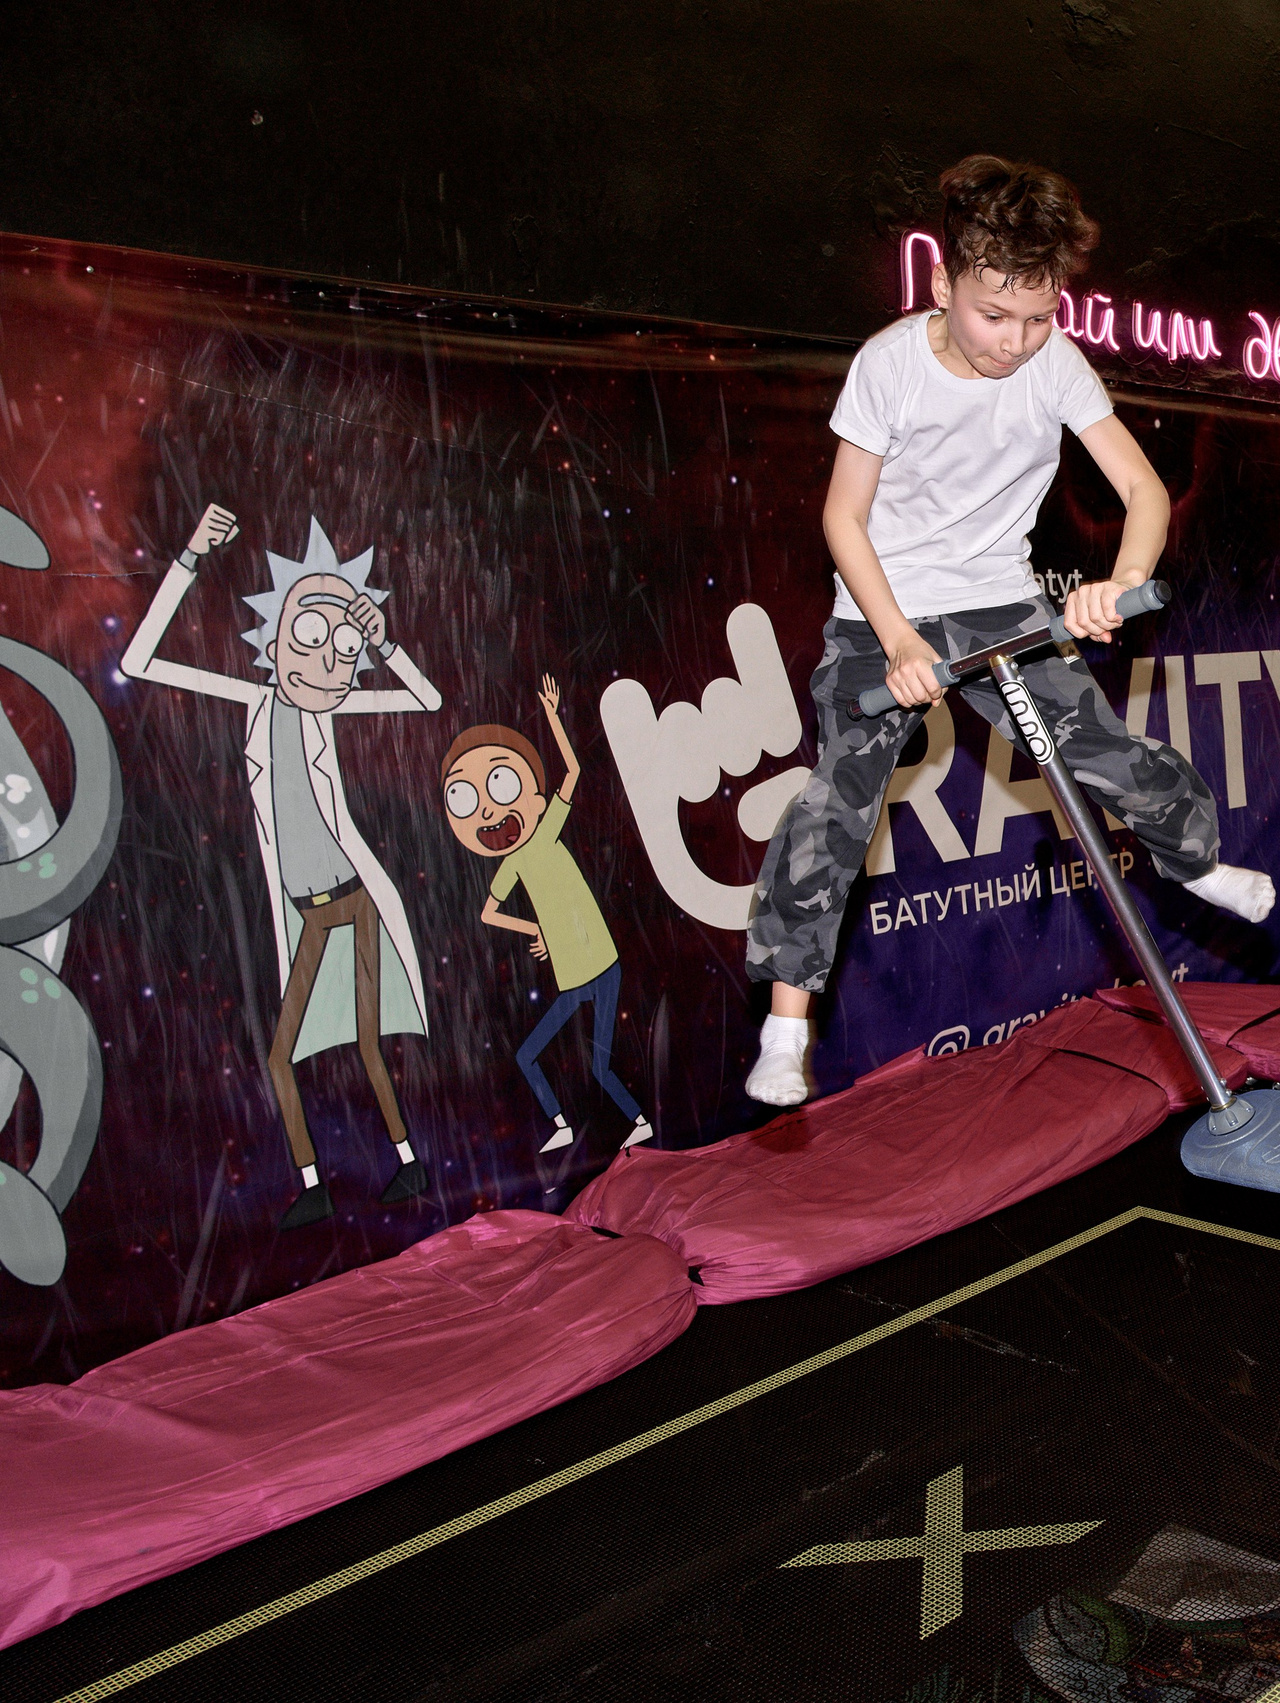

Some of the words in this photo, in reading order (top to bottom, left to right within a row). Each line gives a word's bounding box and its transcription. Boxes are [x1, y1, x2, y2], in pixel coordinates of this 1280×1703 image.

[1133, 299, 1222, 361] или
[869, 862, 1042, 935] БАТУТНЫЙ
[1049, 851, 1134, 898] ЦЕР
